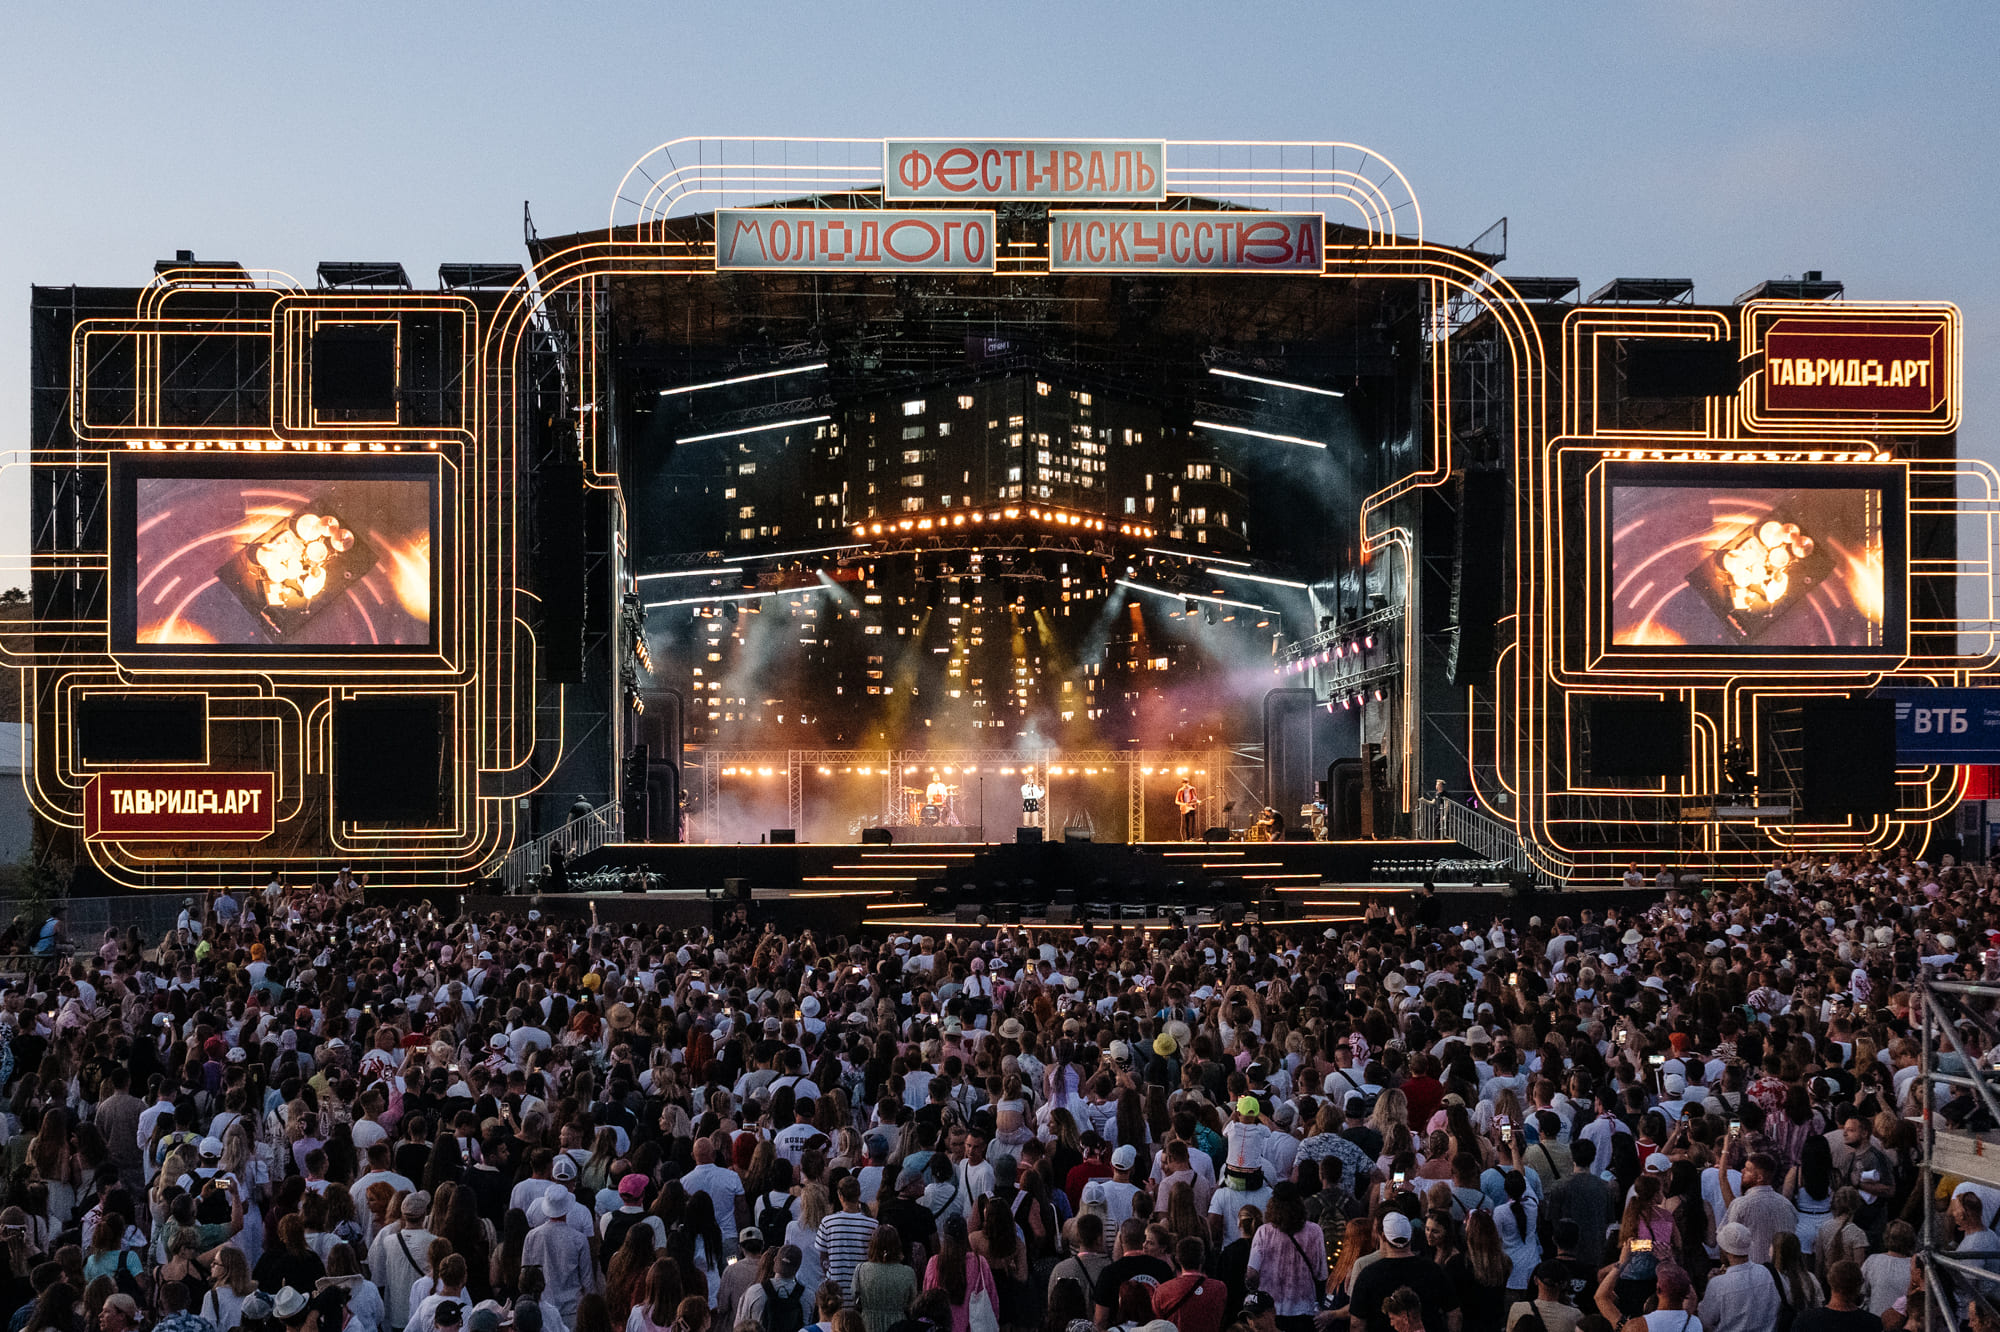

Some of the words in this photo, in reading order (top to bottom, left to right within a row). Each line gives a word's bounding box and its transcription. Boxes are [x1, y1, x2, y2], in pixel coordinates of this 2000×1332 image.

[728, 219, 985, 263] МОЛОДОГО
[1061, 221, 1316, 265] ИСКУССТВА
[1769, 358, 1930, 387] ТАВРИДА.АРТ
[1914, 708, 1968, 733] ВТБ
[110, 789, 262, 814] ТАВРИДА.АРТ
